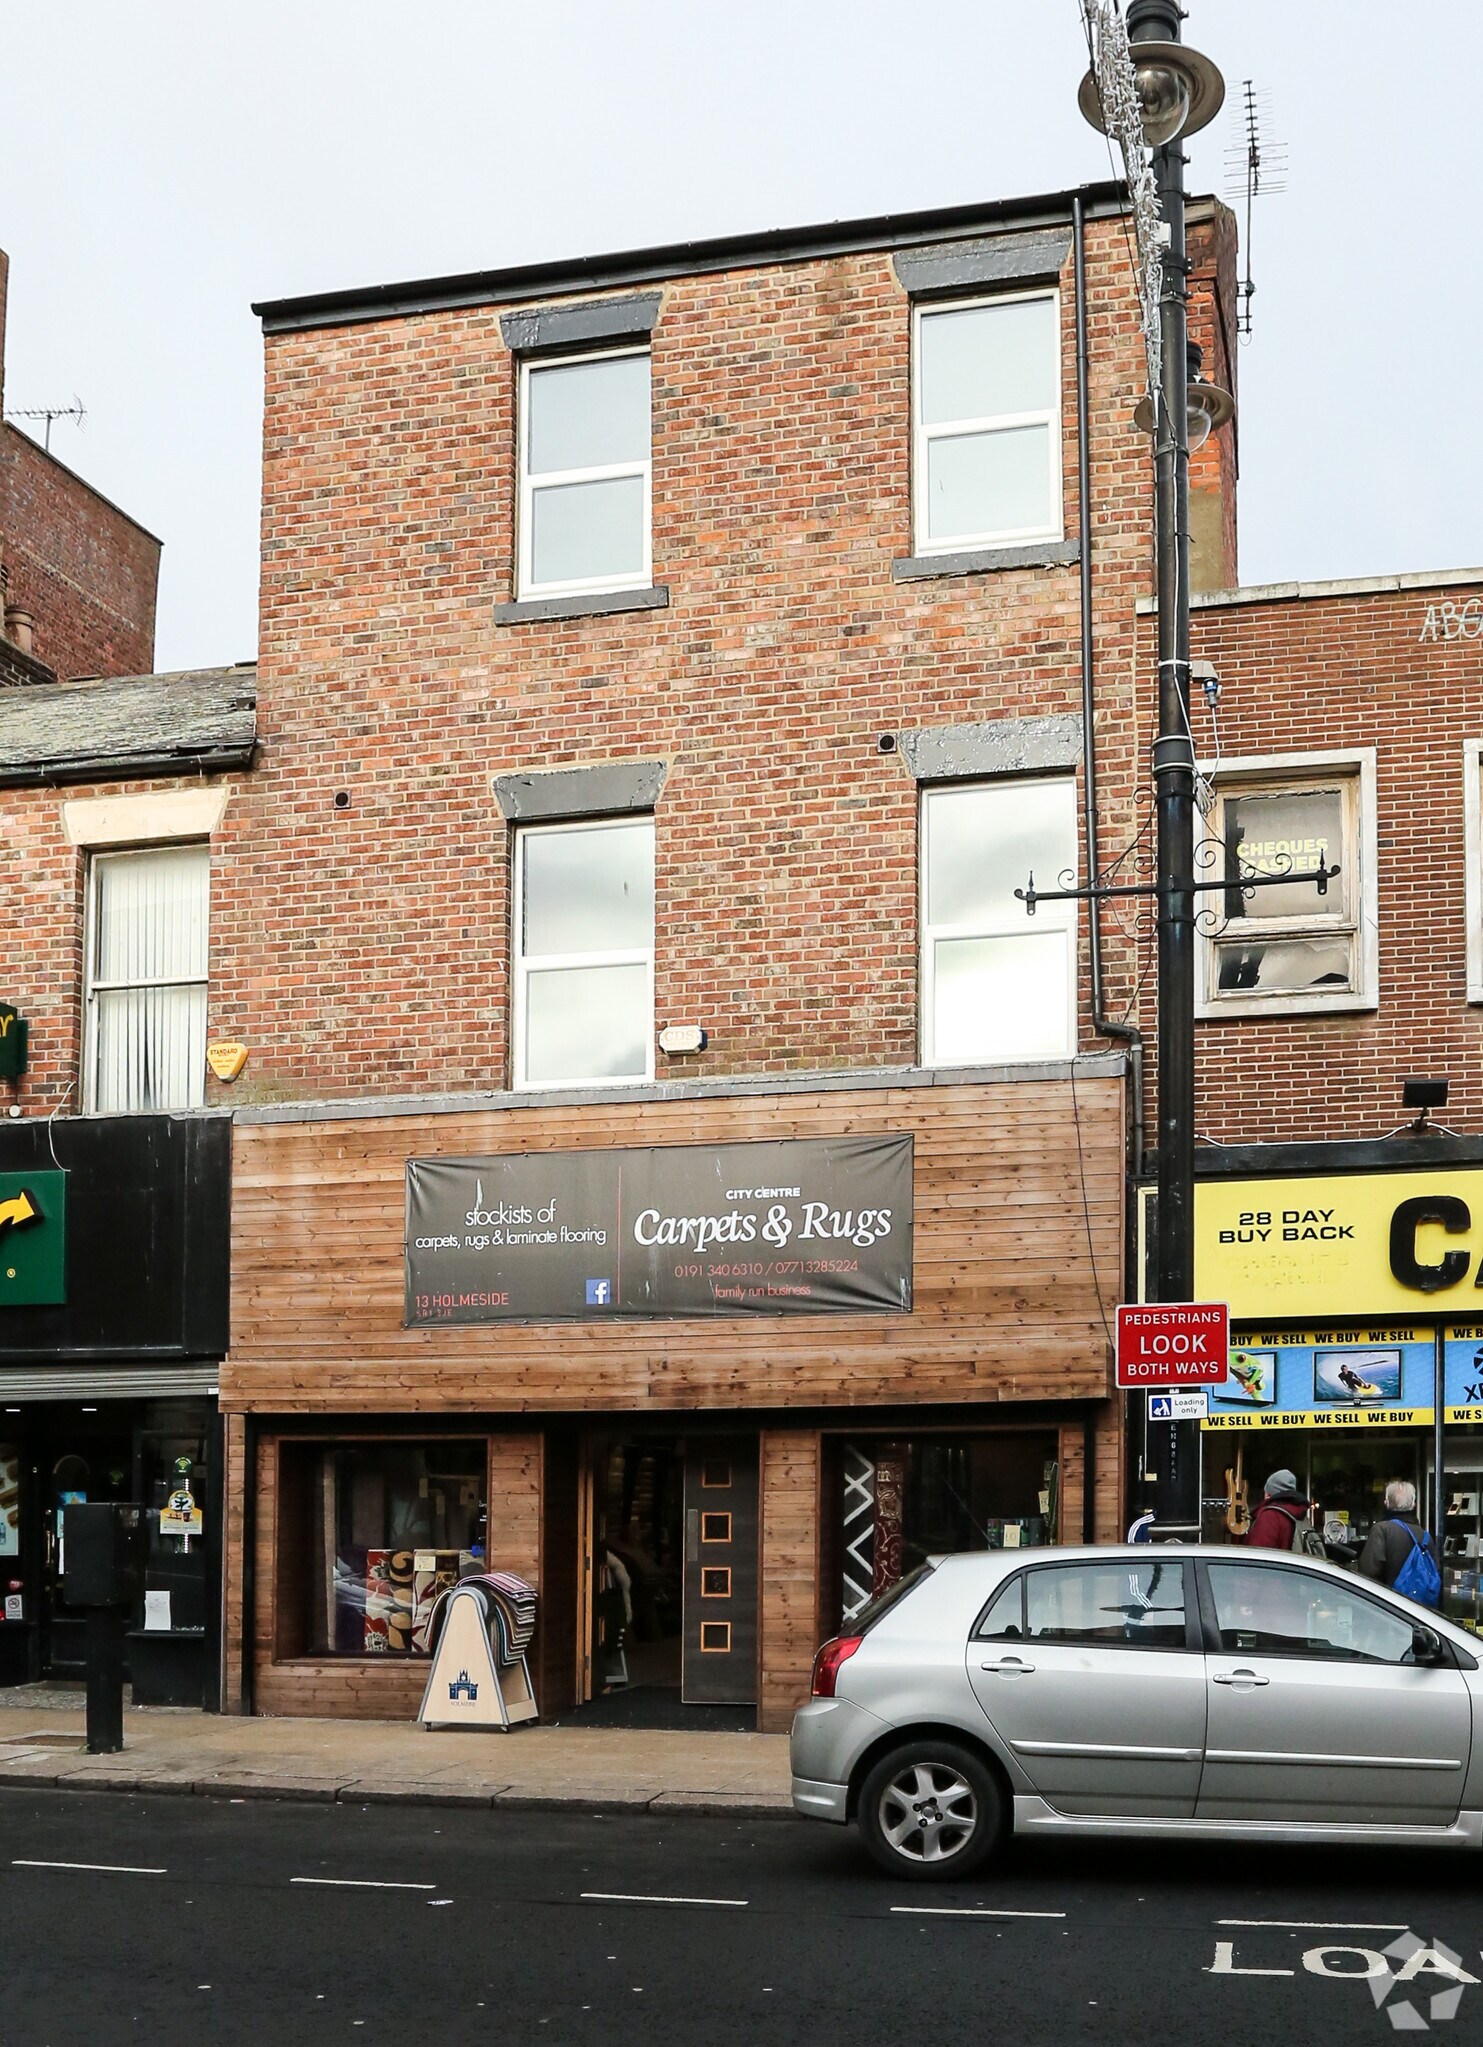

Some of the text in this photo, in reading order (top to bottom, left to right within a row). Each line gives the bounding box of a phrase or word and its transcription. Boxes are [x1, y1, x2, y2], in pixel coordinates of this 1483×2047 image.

[1236, 838, 1328, 858] CHEQUES
[726, 1187, 800, 1200] CITY CENTRE
[465, 1198, 557, 1226] stockists of
[1239, 1209, 1335, 1226] 28 DAY
[634, 1202, 892, 1253] Carpets & Rugs
[1219, 1226, 1355, 1243] BUY BACK
[415, 1226, 606, 1252] carpets, rugs & laminate flooring
[1389, 1195, 1483, 1290] C
[674, 1265, 703, 1277] 0191
[775, 1260, 858, 1273] 07713285224
[415, 1292, 509, 1307] 13 HOLMESIDE
[715, 1282, 811, 1300] family run business
[1125, 1312, 1221, 1325] PEDESTRIANS
[1229, 1330, 1415, 1346] BUY WE SELL WE BUY WE SELL
[1453, 1328, 1473, 1338] WE
[1140, 1334, 1207, 1355] LOOK
[1127, 1361, 1219, 1376] BOTH WAYS
[1174, 1399, 1205, 1407] Loading
[1207, 1412, 1414, 1426] WE SELL WE BUY WE SELL WE BUY
[1453, 1410, 1472, 1420] WE
[1209, 1942, 1483, 1984] LOA
